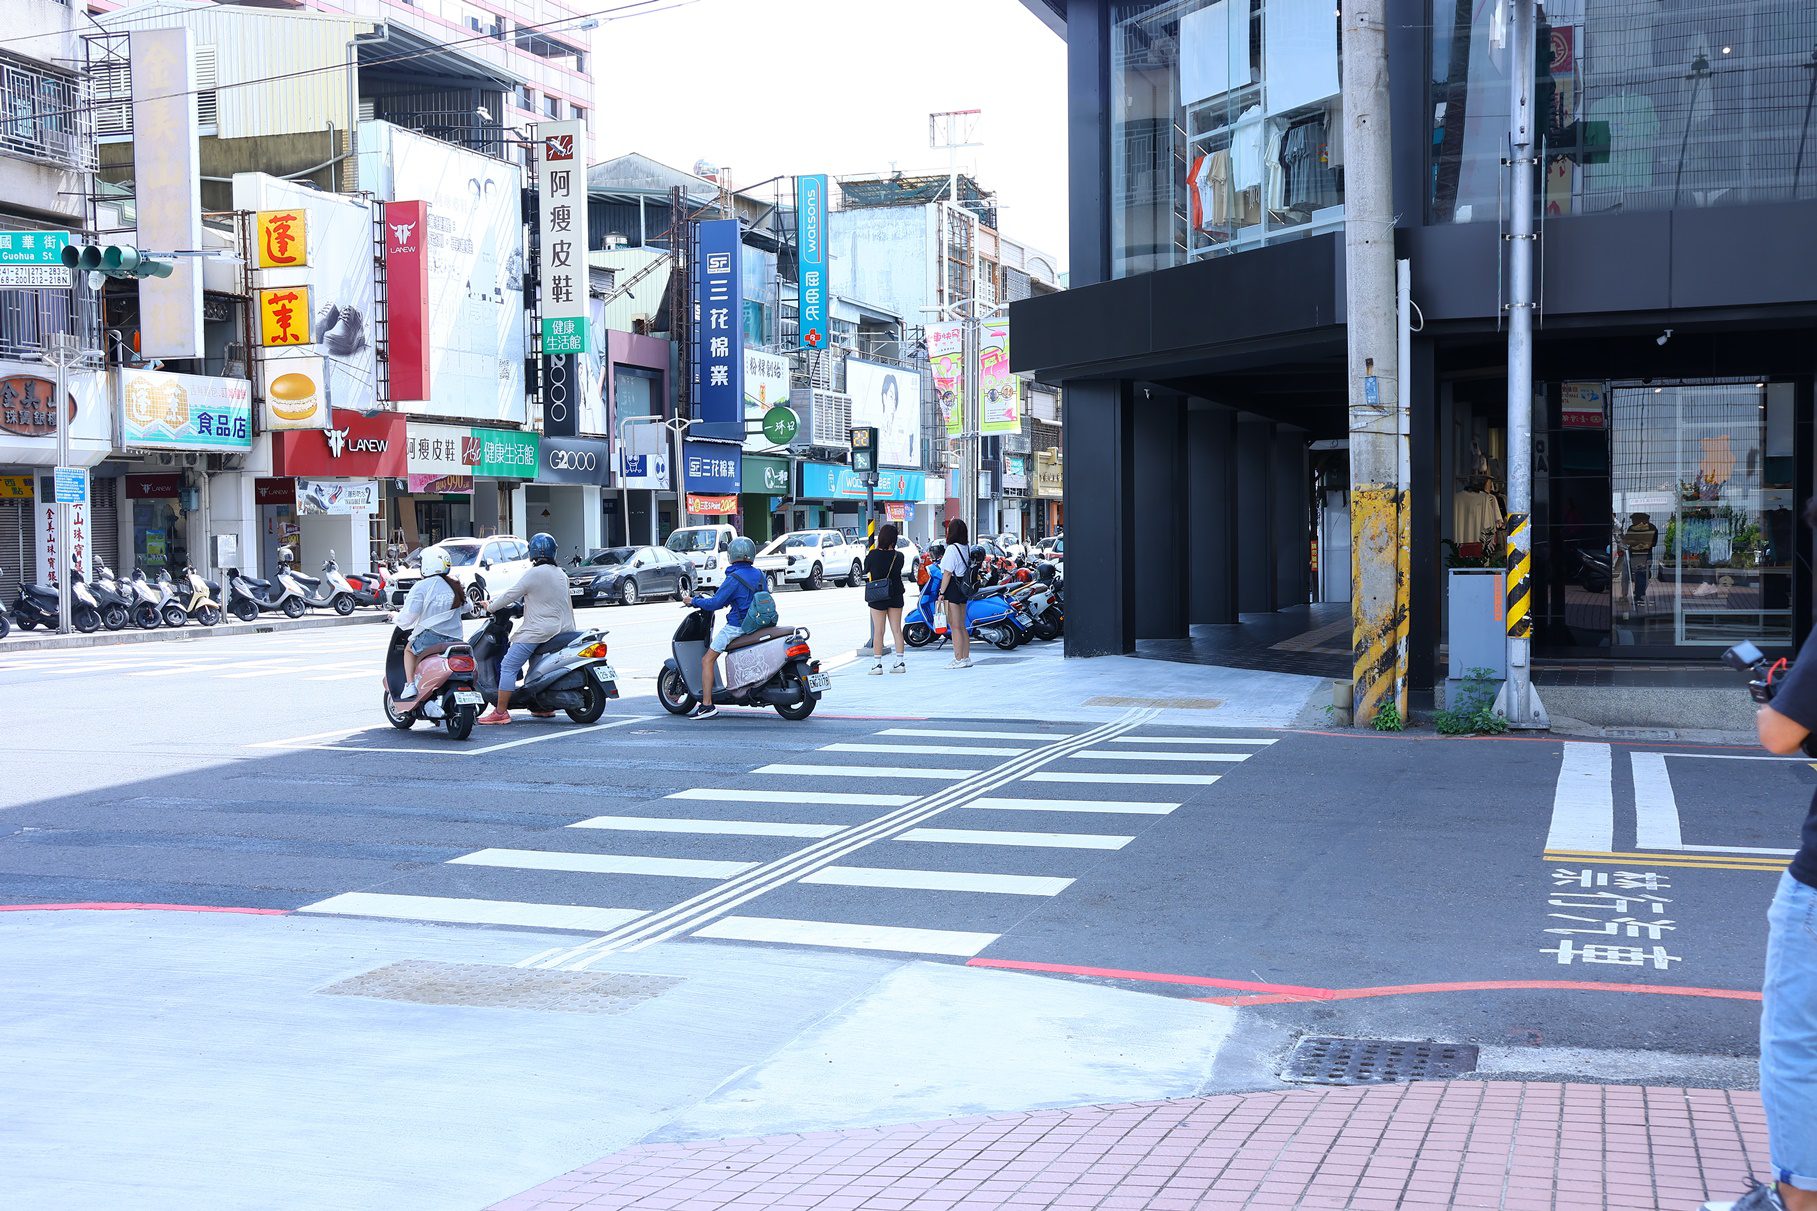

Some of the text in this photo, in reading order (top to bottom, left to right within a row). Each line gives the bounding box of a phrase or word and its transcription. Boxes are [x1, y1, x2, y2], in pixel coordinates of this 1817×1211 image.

[807, 189, 816, 252] watsons
[0, 235, 57, 249] 國華街
[550, 170, 573, 303] 阿瘦皮鞋
[2, 252, 55, 260] Guohua St.
[806, 271, 820, 321] 屈臣氏
[551, 320, 576, 335] 健康
[709, 280, 729, 387] 三花棉業
[546, 336, 582, 350] 生活館
[197, 411, 247, 439] 食品店
[853, 430, 869, 447] 22
[484, 441, 535, 465] 健康生活館
[550, 450, 596, 471] G2000
[703, 459, 735, 478] 三花棉業
[1539, 868, 1682, 970] 禁行汽車
